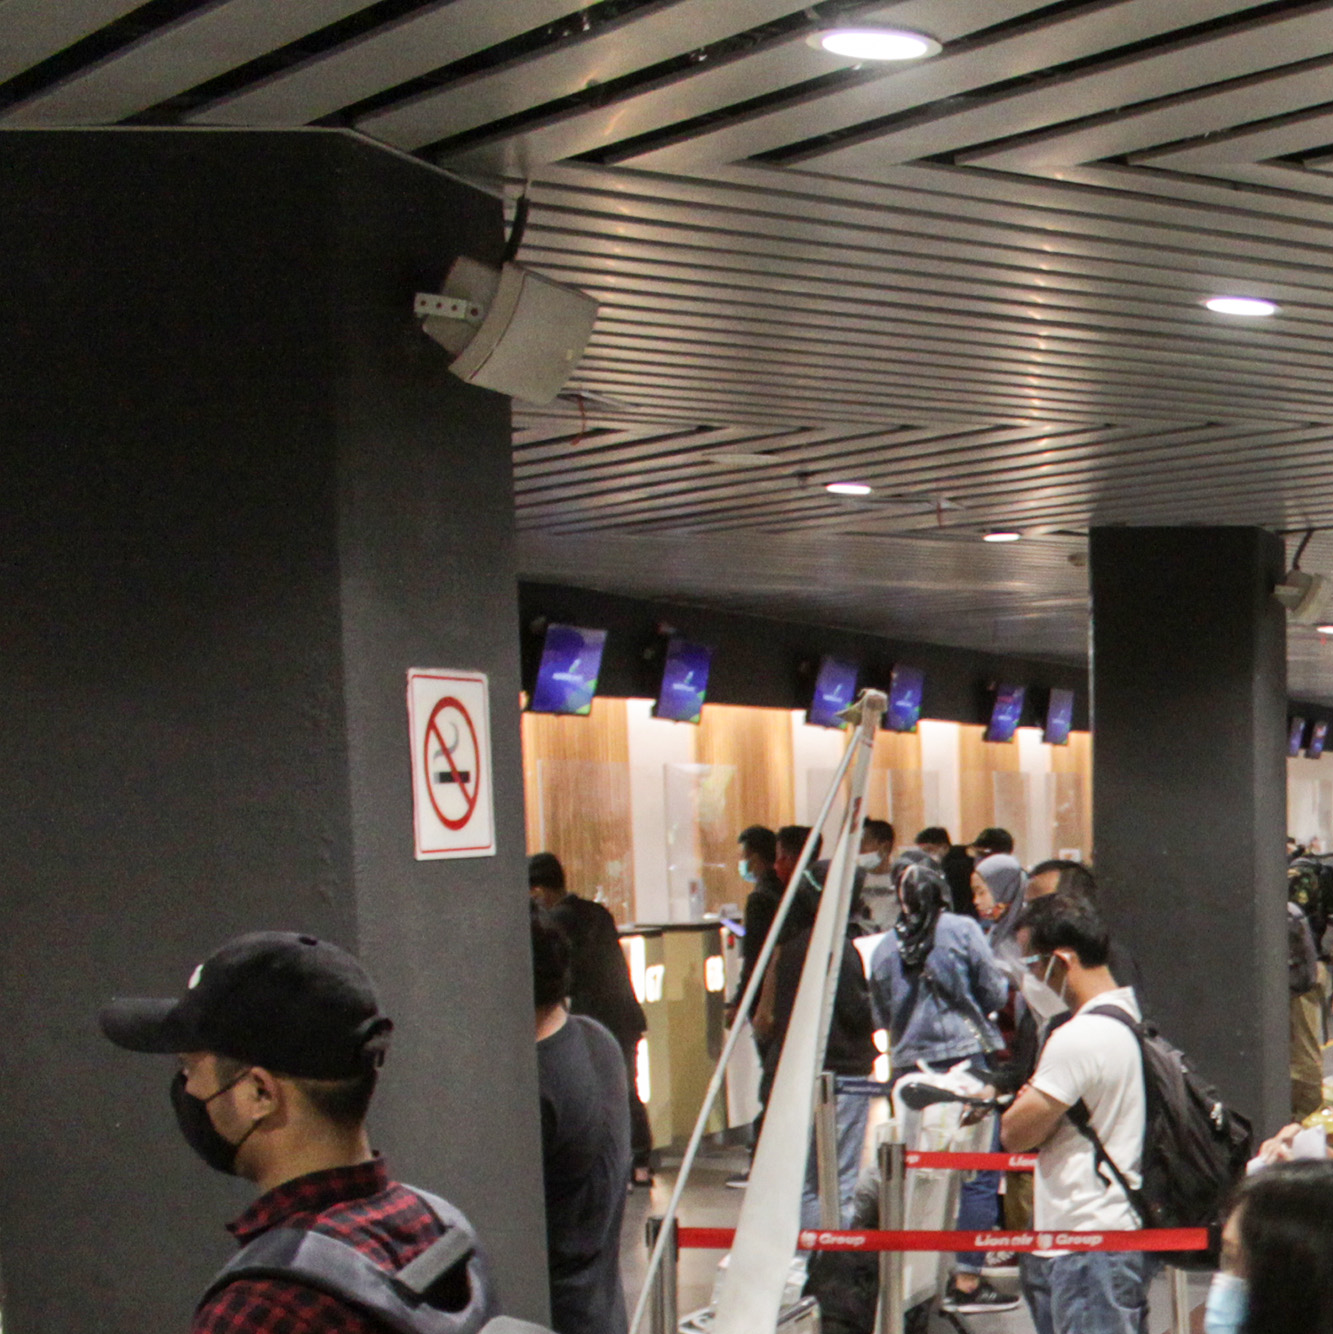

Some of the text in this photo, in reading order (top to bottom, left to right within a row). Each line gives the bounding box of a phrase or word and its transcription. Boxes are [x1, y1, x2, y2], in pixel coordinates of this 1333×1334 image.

[818, 1233, 865, 1247] Group
[975, 1233, 1010, 1246] Lion
[1055, 1234, 1103, 1247] Group
